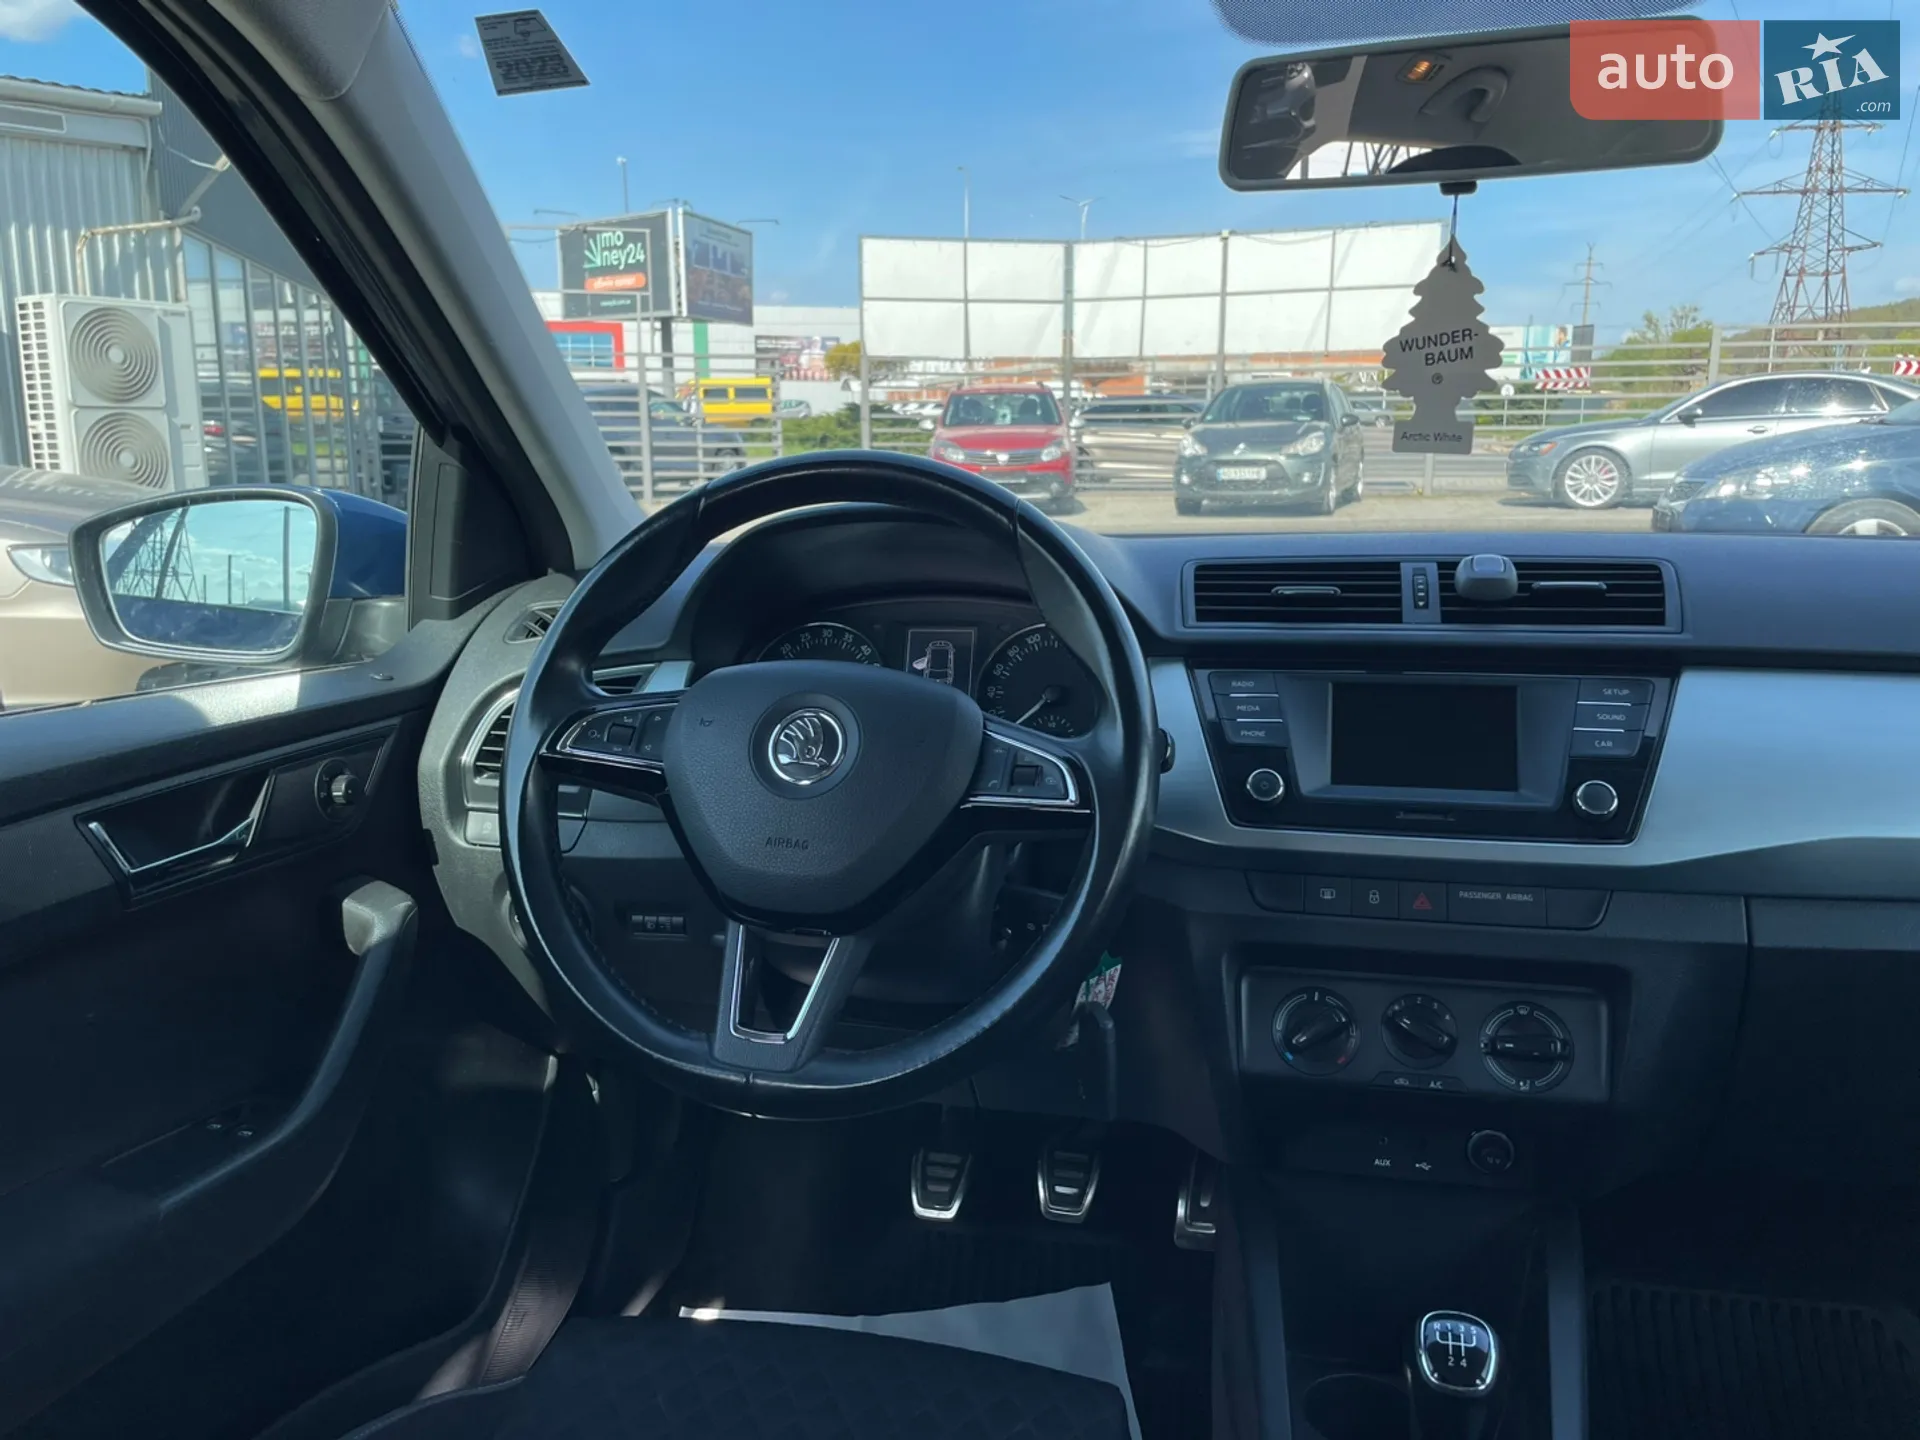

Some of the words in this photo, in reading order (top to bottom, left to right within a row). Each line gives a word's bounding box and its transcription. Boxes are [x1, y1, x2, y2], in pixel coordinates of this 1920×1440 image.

[601, 230, 624, 248] mo
[601, 243, 645, 269] ney24
[1399, 327, 1479, 353] WUNDER-
[1424, 346, 1474, 366] BAUM
[1400, 431, 1431, 442] Arctic
[1433, 431, 1463, 443] White
[822, 628, 833, 638] 30
[842, 632, 854, 643] 35
[860, 644, 872, 656] 40
[1025, 633, 1041, 644] 100
[1596, 713, 1626, 721] SOUND
[765, 836, 808, 850] AIRBAG
[1458, 890, 1501, 900] PASSENGER
[1505, 892, 1533, 902] AIRBAG
[1374, 1159, 1391, 1167] AUX
[1447, 1356, 1455, 1366] 2
[1460, 1358, 1467, 1368] 4
